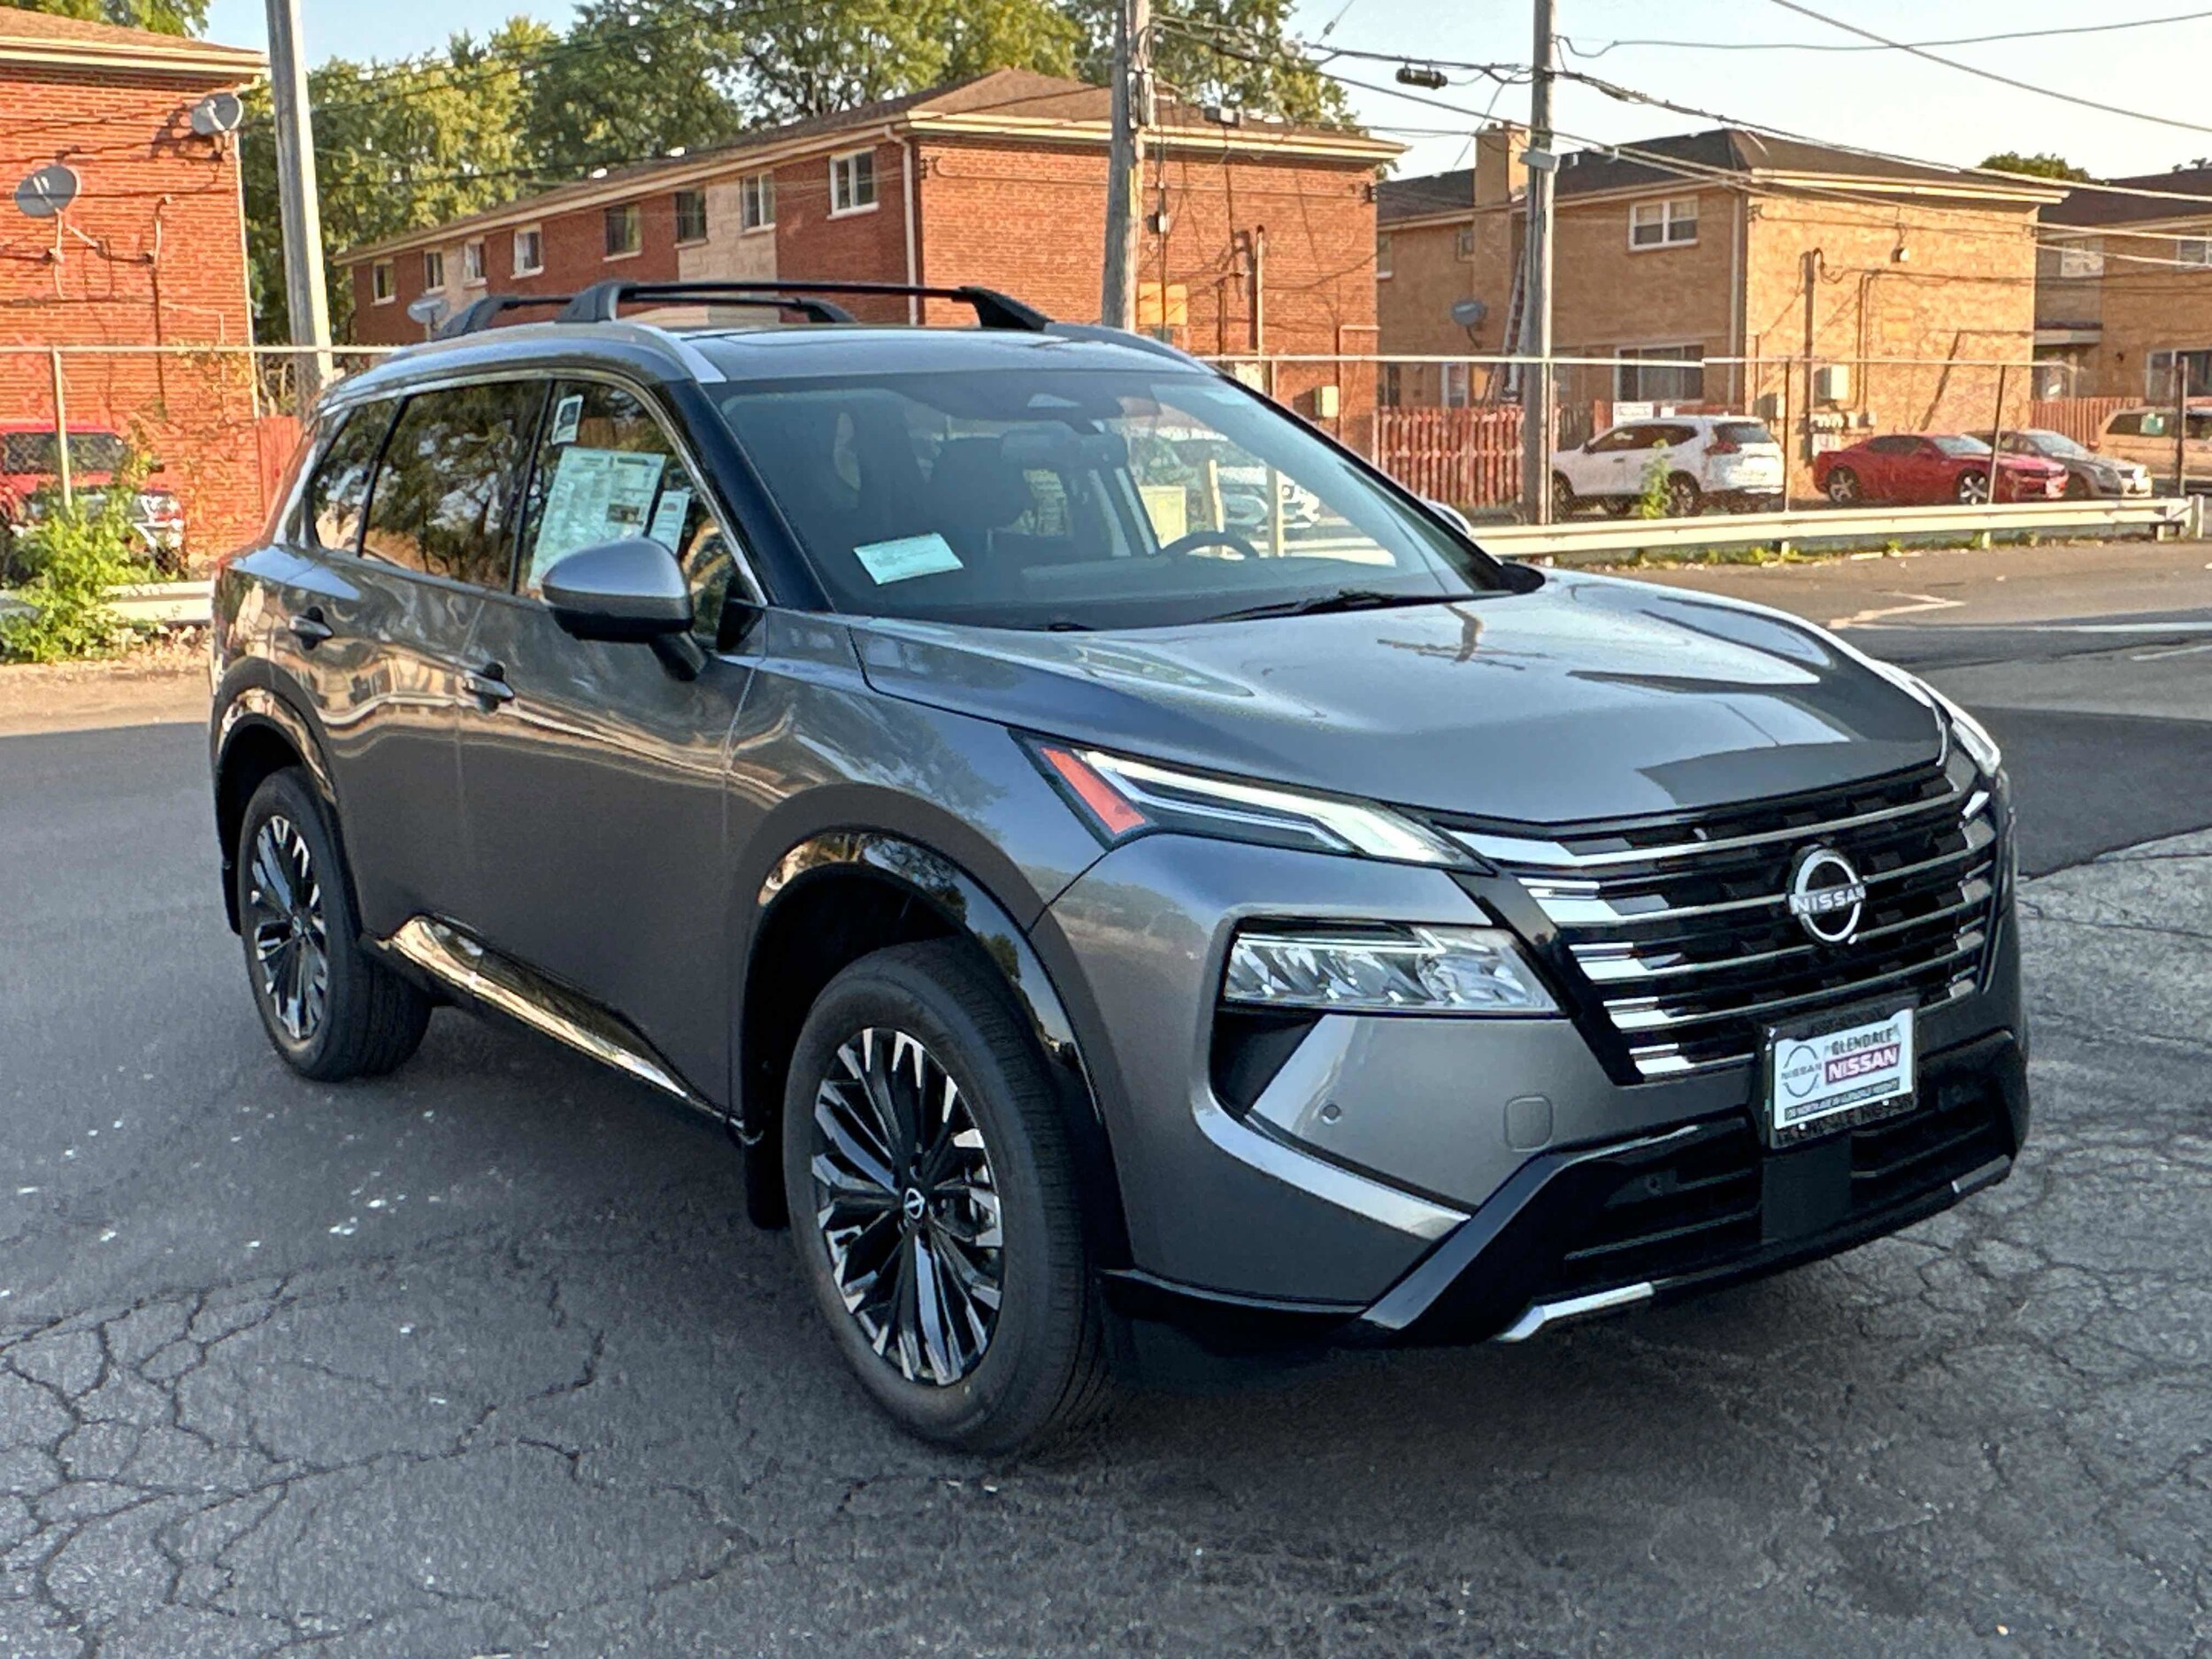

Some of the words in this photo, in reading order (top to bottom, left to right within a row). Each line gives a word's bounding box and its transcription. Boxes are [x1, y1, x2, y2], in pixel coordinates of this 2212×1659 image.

[1789, 885, 1866, 915] NISSAN
[1832, 1027, 1892, 1056] GLENDALE
[1781, 1063, 1822, 1079] NISSAN
[1828, 1047, 1897, 1081] NISSAN
